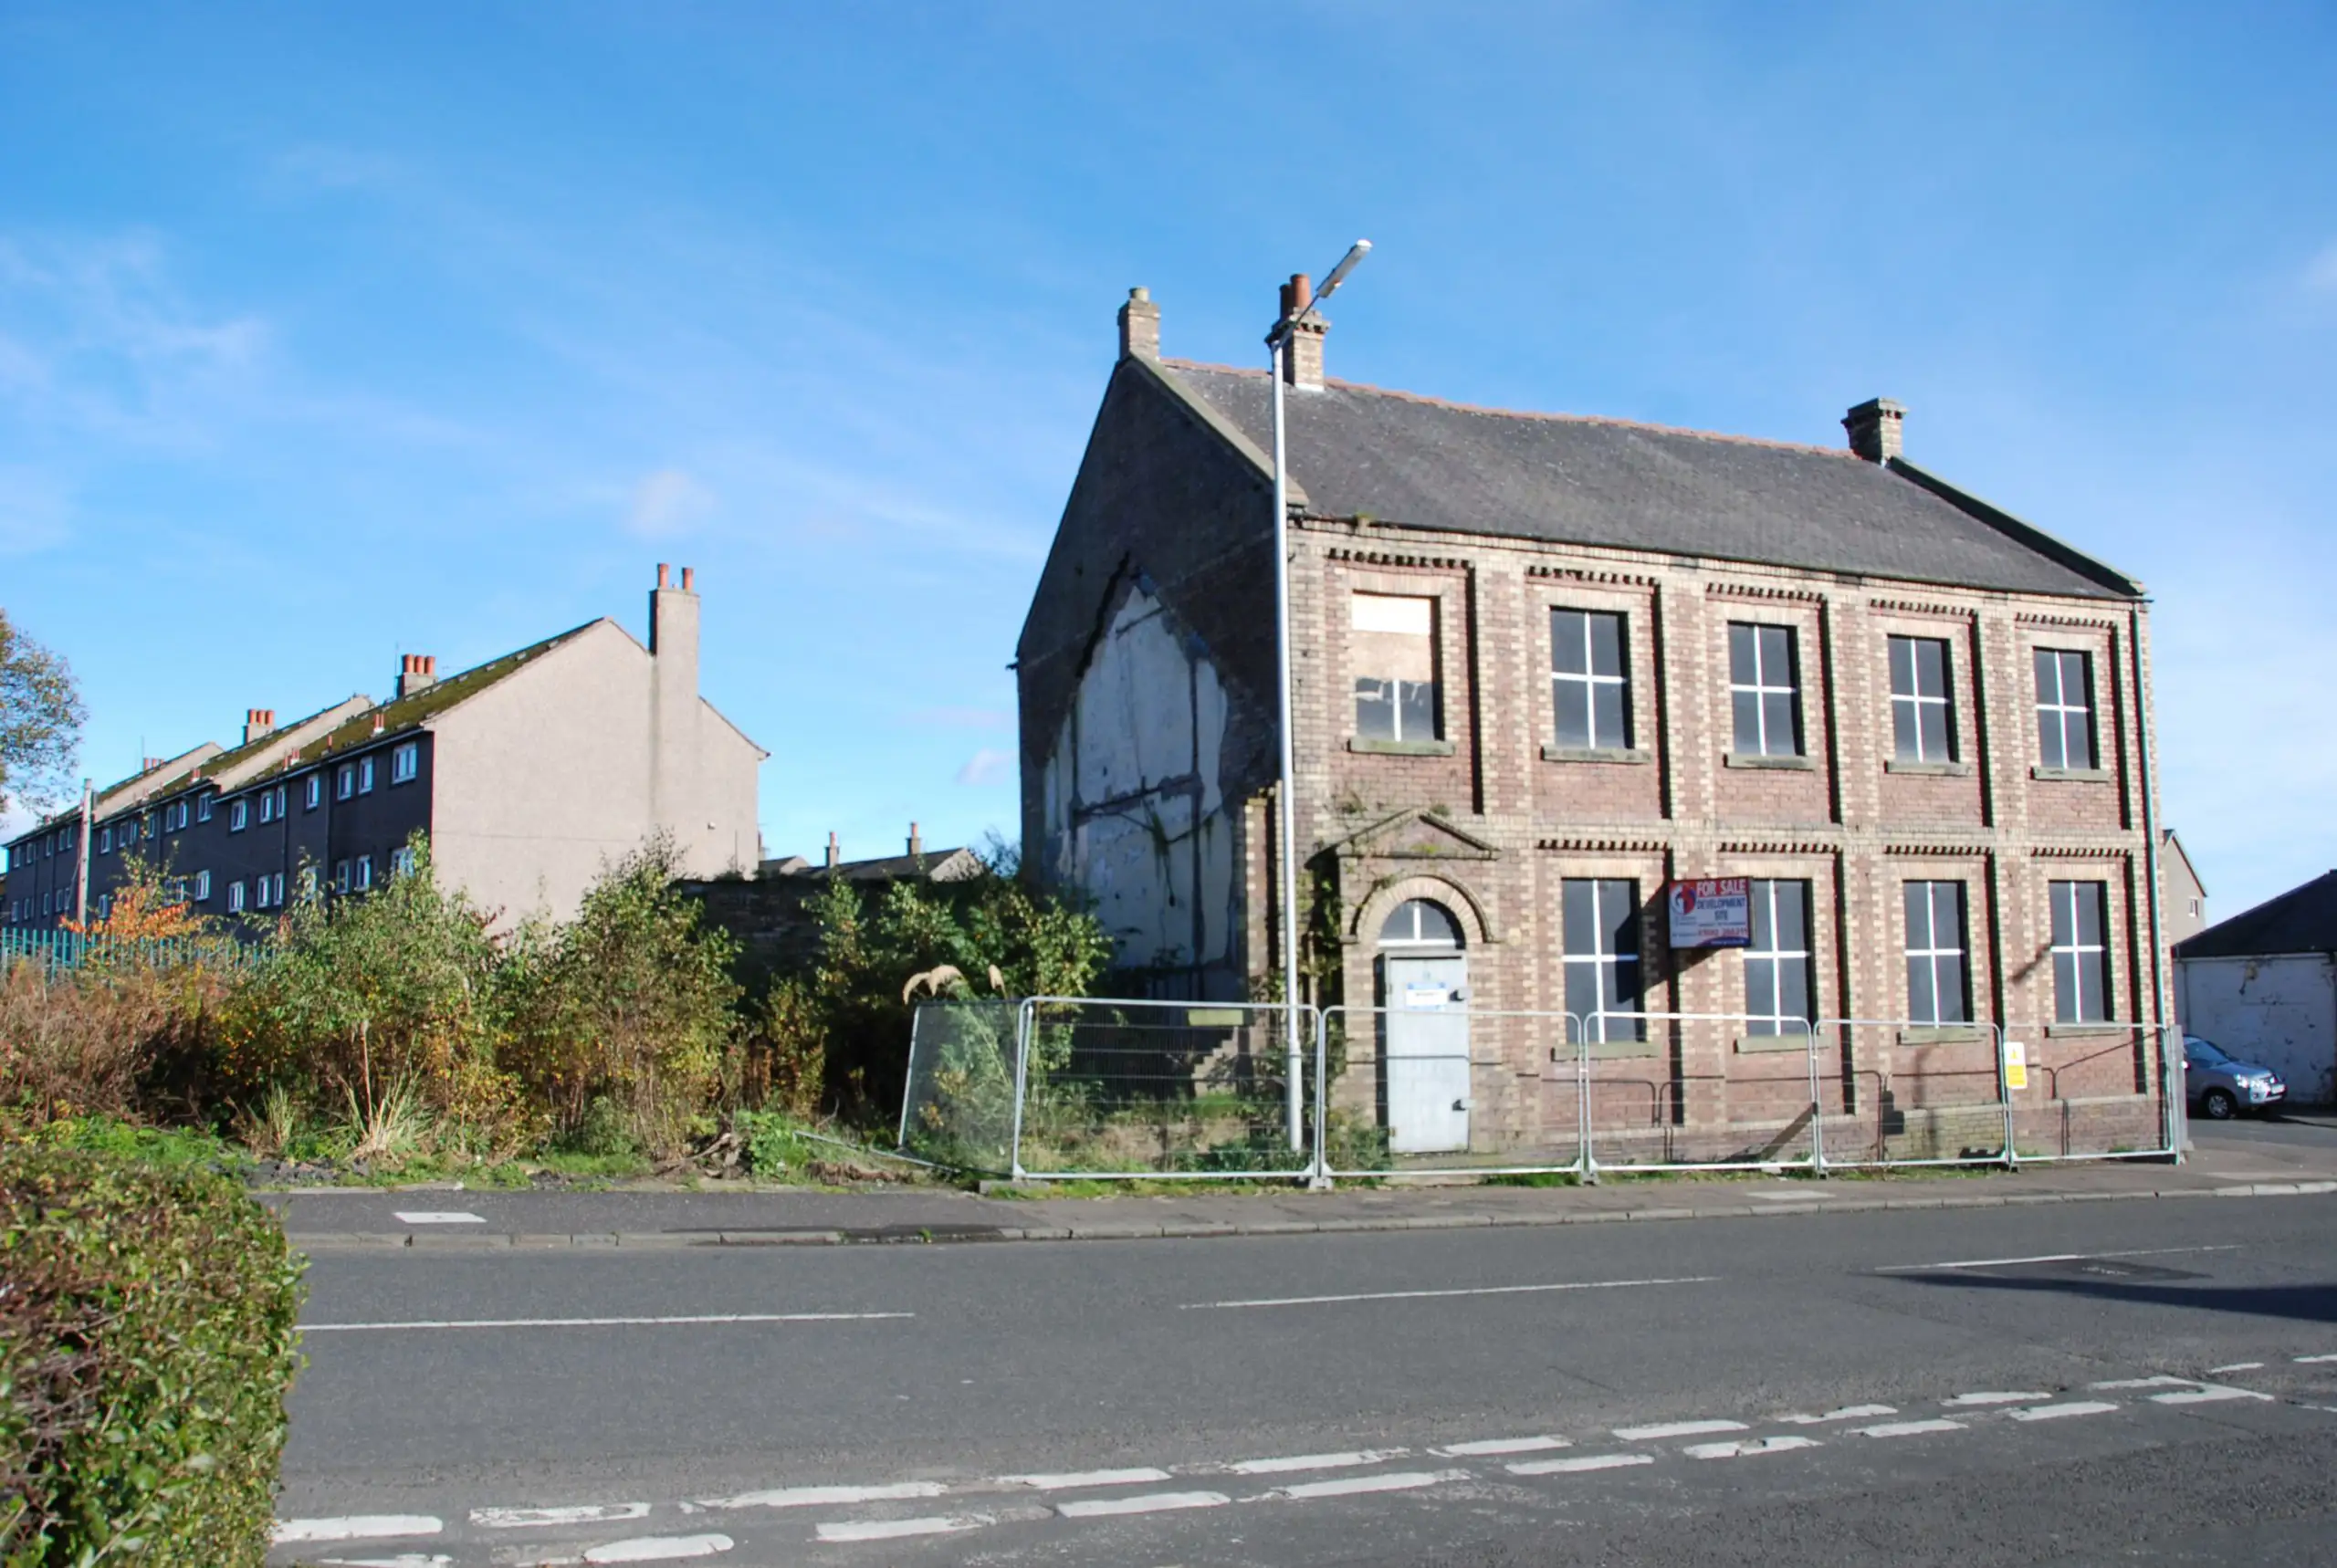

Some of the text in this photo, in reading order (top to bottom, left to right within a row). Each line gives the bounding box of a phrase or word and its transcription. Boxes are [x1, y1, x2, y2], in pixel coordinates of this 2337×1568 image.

[1696, 879, 1746, 896] FOR SALE
[1696, 897, 1745, 910] DEVELOPMENT
